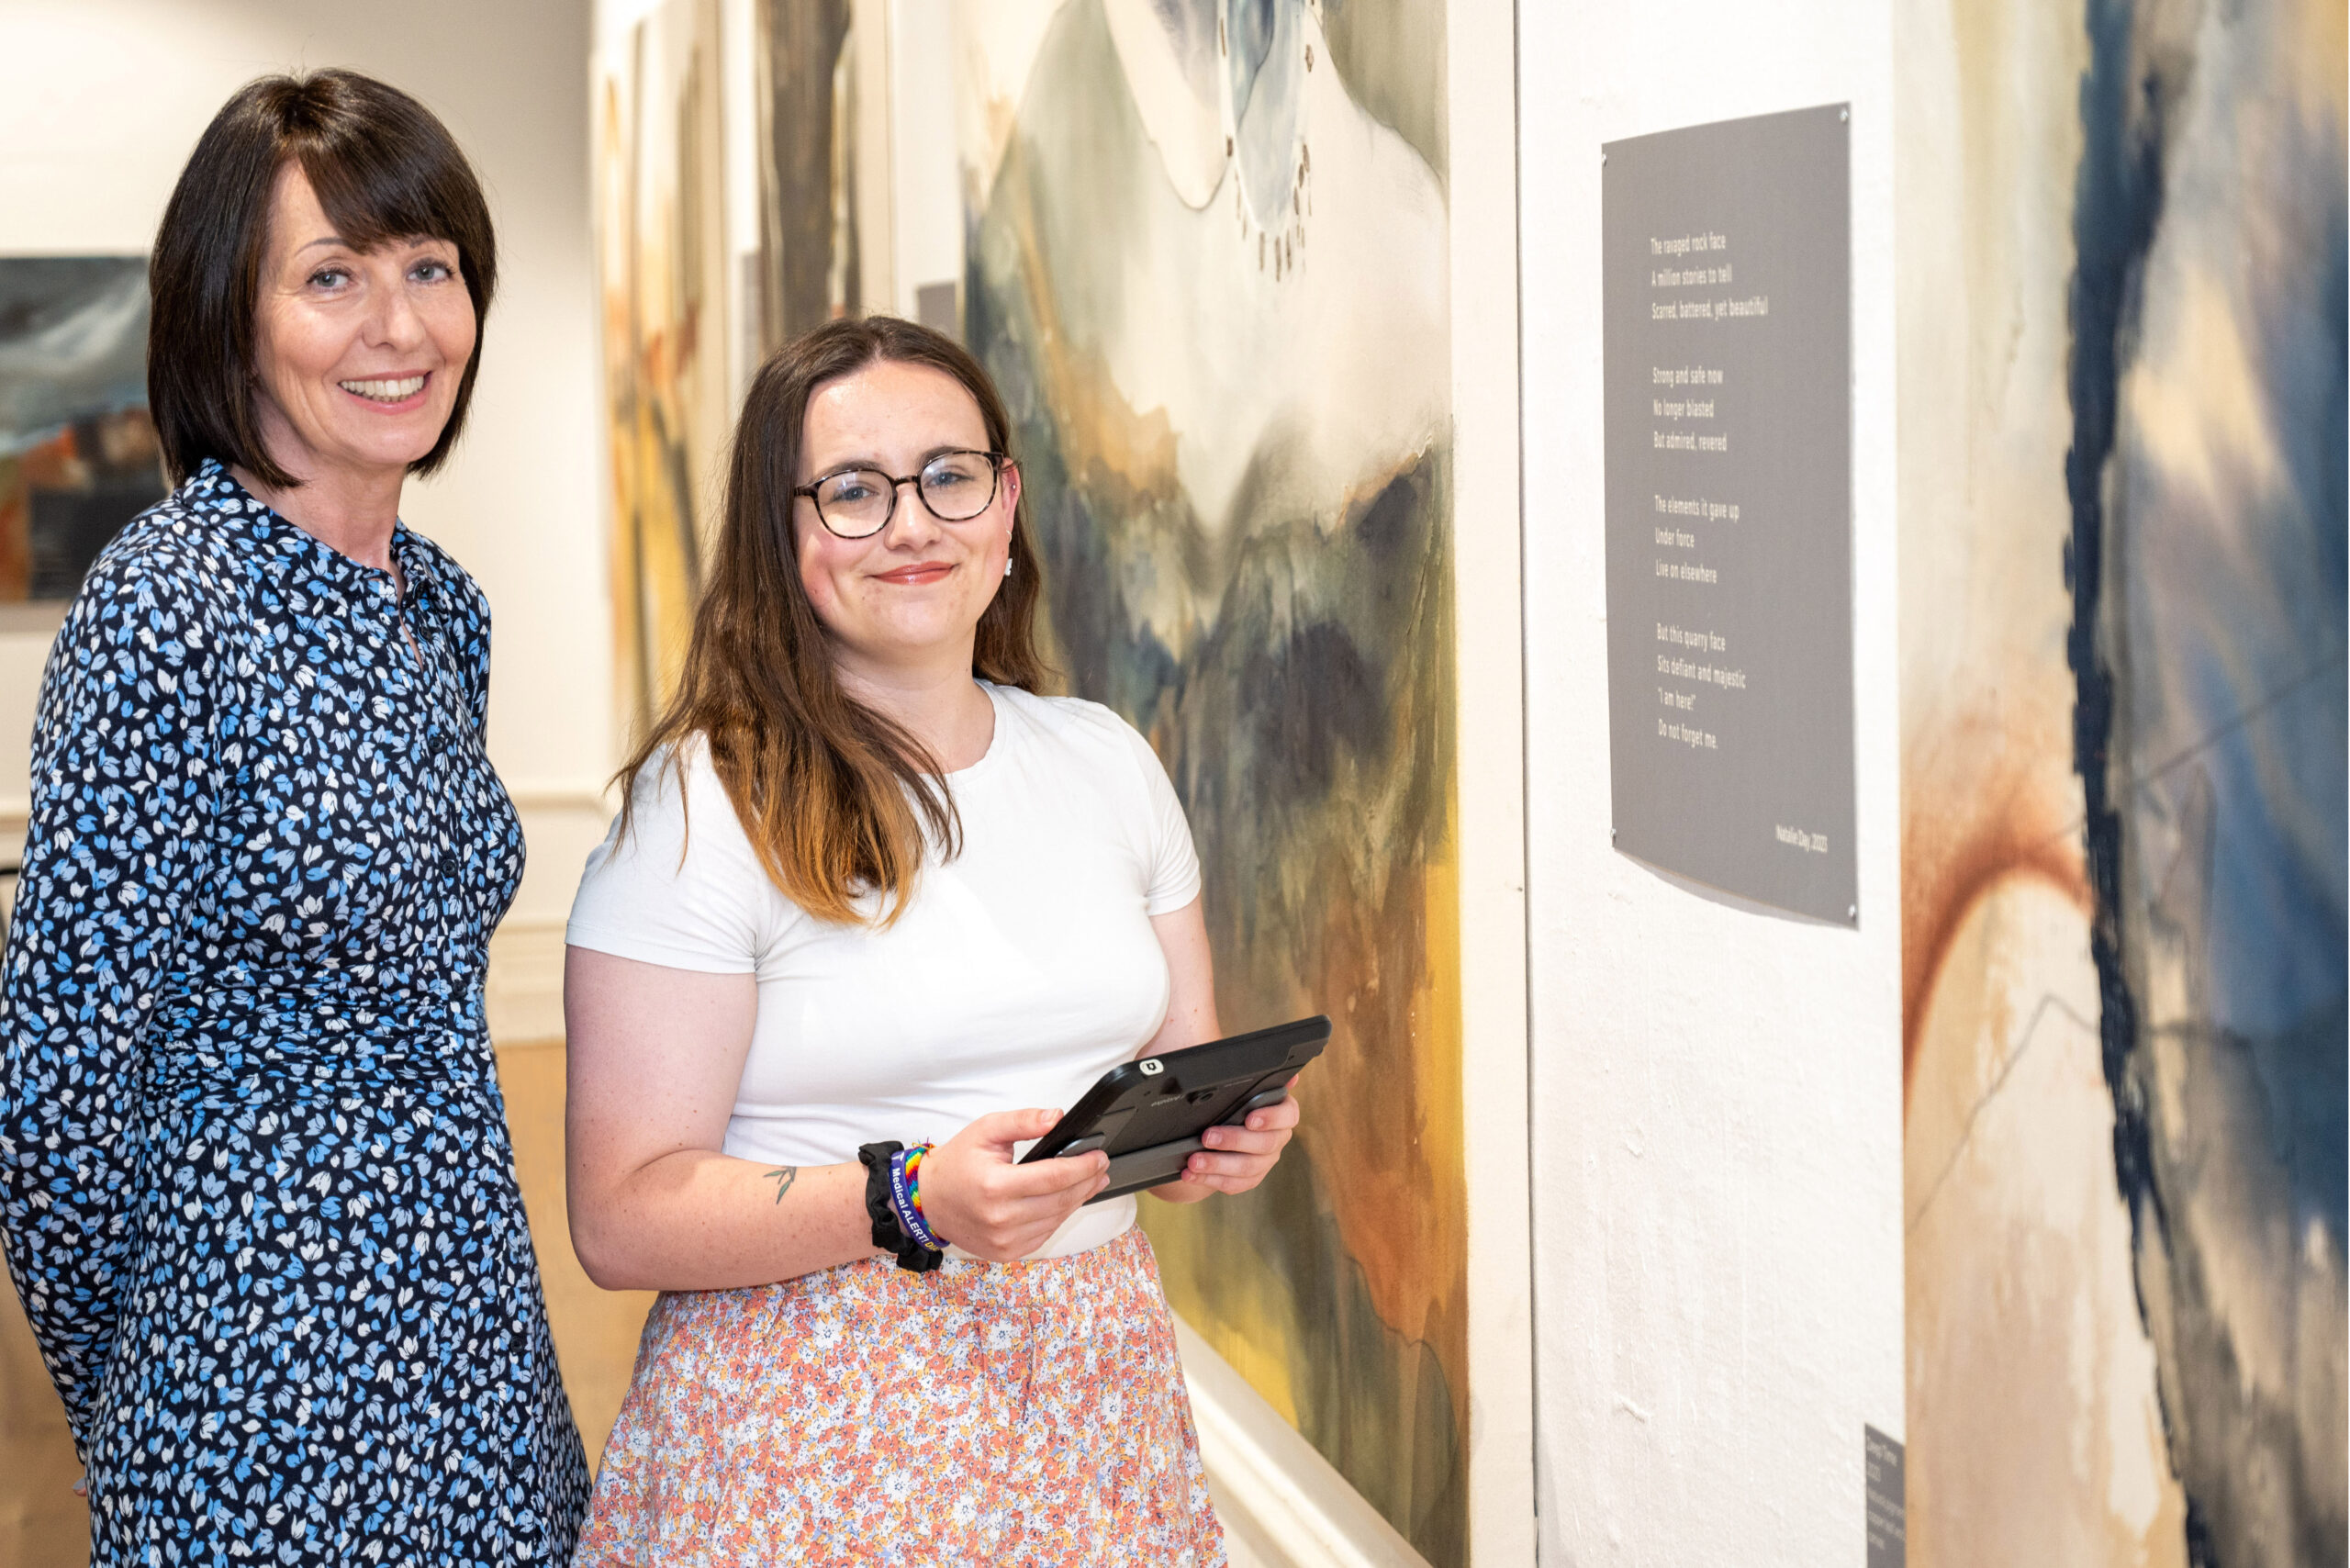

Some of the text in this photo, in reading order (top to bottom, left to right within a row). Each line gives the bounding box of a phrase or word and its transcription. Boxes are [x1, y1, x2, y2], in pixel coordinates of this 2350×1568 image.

[1651, 231, 1726, 257] The ravaged rock face
[1658, 268, 1680, 286] million
[1683, 265, 1707, 286] stories
[1708, 267, 1717, 284] to
[1718, 263, 1731, 283] tell
[1652, 296, 1768, 321] Scarred, battered, yet beautiful
[1653, 365, 1723, 387] Strong and safe now
[1654, 398, 1714, 420] No longer blasted
[1654, 431, 1727, 451] But admired, revered
[1655, 495, 1739, 523] The elements it gave up
[1655, 527, 1695, 548] Under force
[1656, 558, 1717, 584] Live on elsewhere
[1657, 622, 1726, 653] But this quarry face
[1658, 655, 1746, 690] Sits defiant and majestic
[1664, 691, 1674, 706] am
[1659, 718, 1718, 749] Do not forget me.
[892, 1167, 908, 1209] Medical
[902, 1210, 929, 1243] ALERT!
